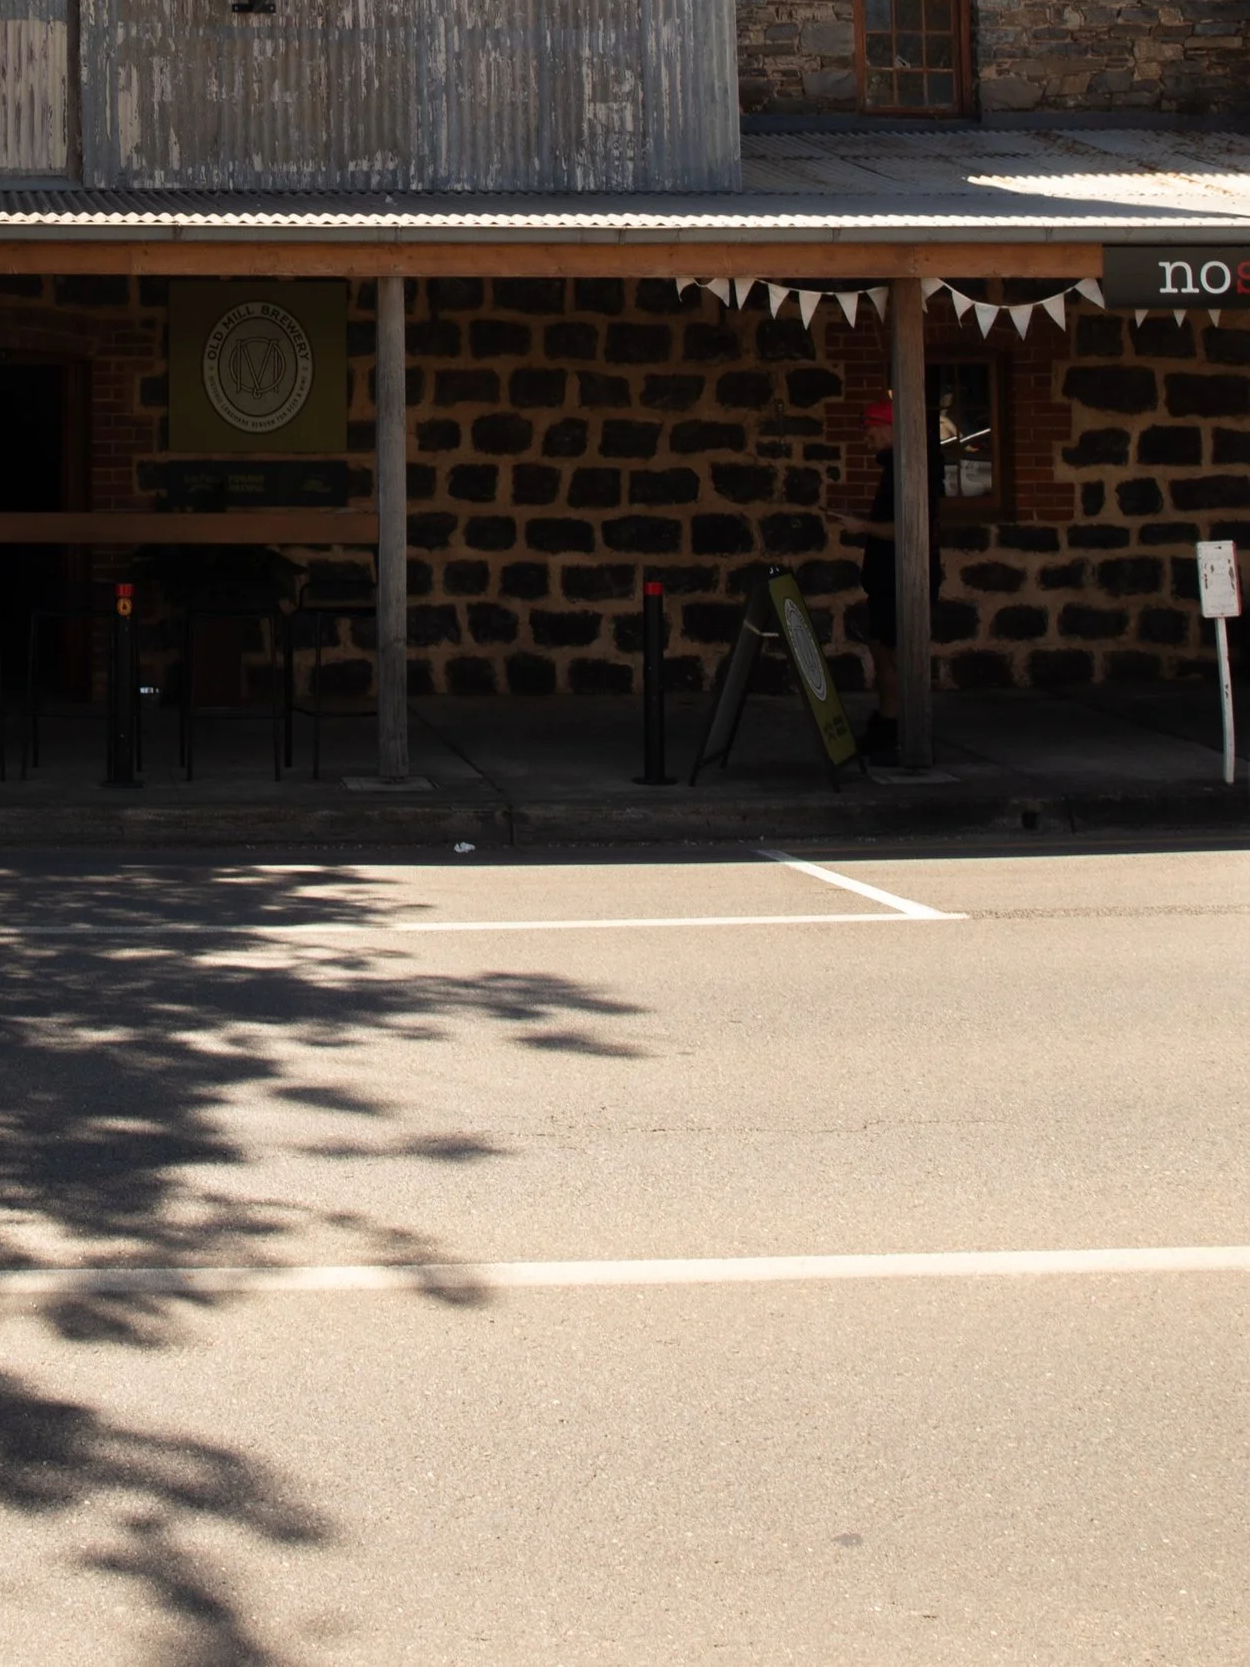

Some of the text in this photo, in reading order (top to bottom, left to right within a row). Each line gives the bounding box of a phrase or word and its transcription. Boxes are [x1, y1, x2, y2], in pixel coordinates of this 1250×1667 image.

[207, 304, 310, 361] OLD MILL BREWERY
